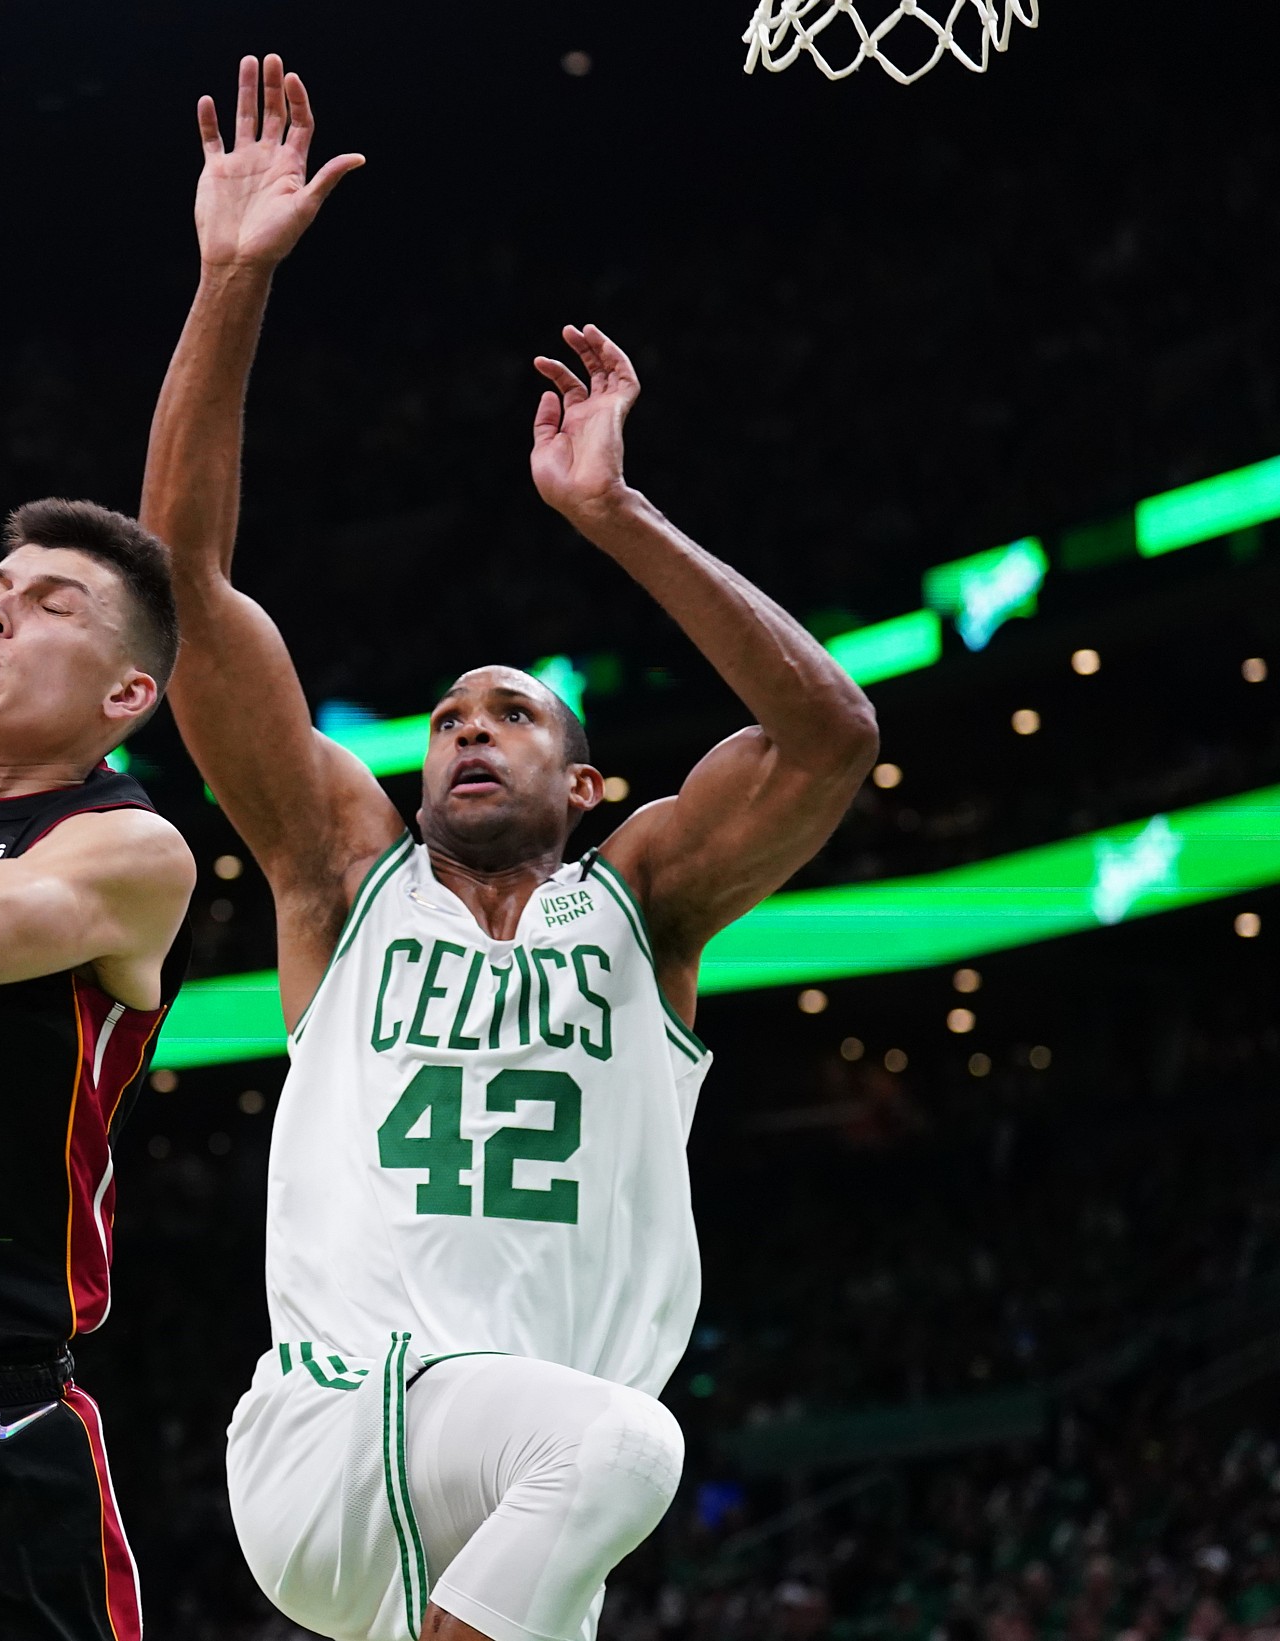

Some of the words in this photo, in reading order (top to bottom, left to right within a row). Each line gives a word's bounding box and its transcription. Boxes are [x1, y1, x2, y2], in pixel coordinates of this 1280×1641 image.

[539, 890, 591, 914] VISTA
[545, 900, 594, 928] PRINT
[370, 938, 612, 1062] CELTICS
[377, 1064, 581, 1225] 42
